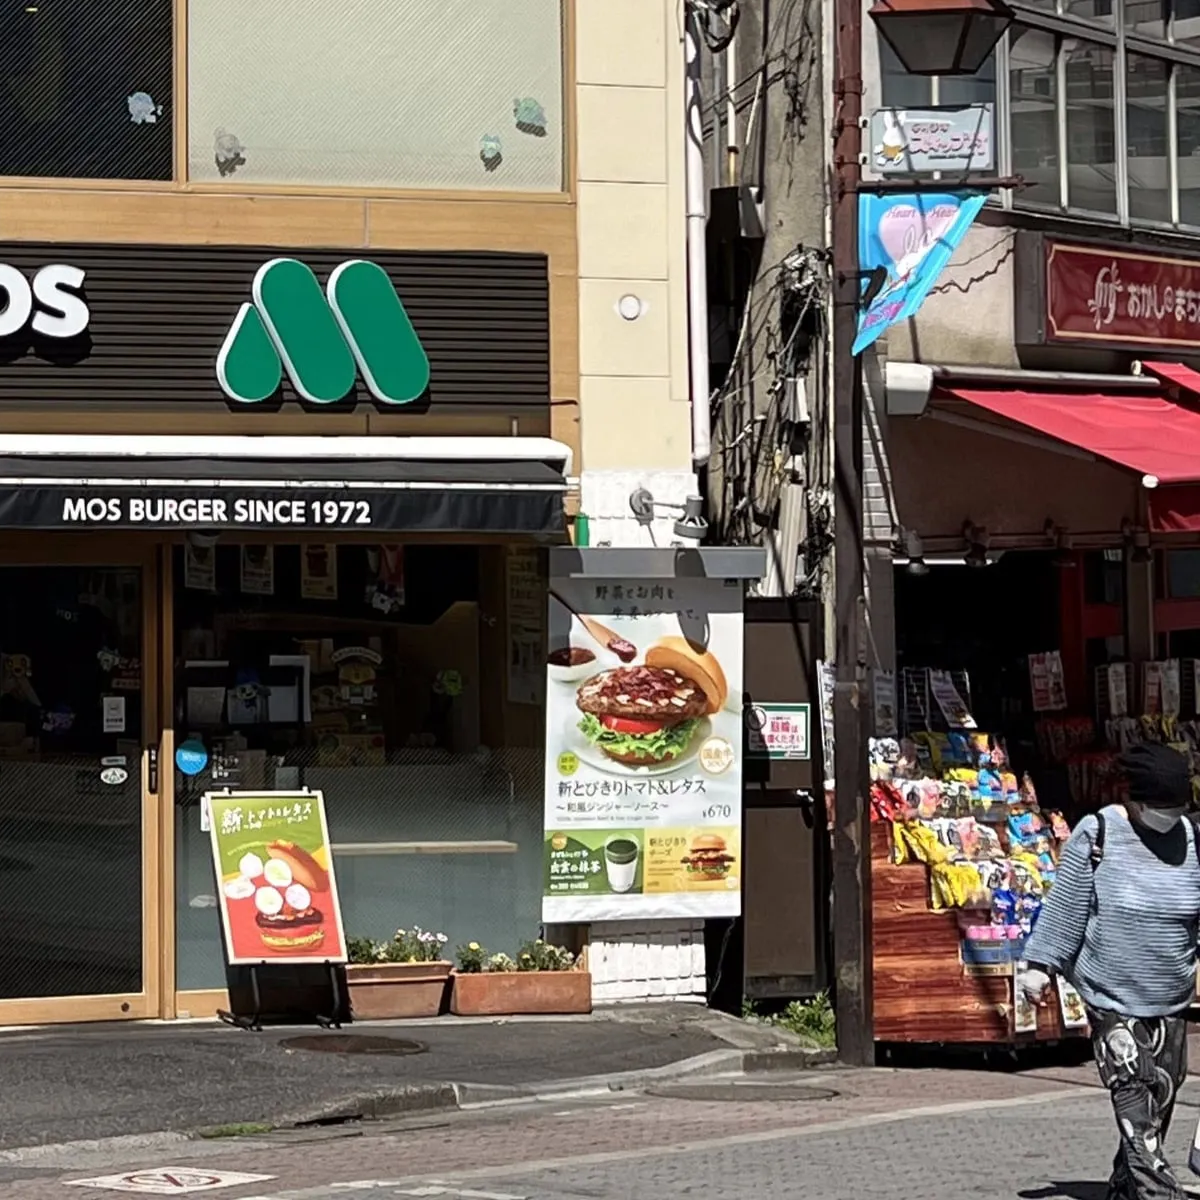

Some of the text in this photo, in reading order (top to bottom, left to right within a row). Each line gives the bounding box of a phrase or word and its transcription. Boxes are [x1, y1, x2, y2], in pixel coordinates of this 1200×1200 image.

[1127, 282, 1200, 324] おかしのまち
[62, 497, 372, 524] MOS BURGER SINCE 1972
[557, 779, 707, 798] 新とびきりトマト&レタス
